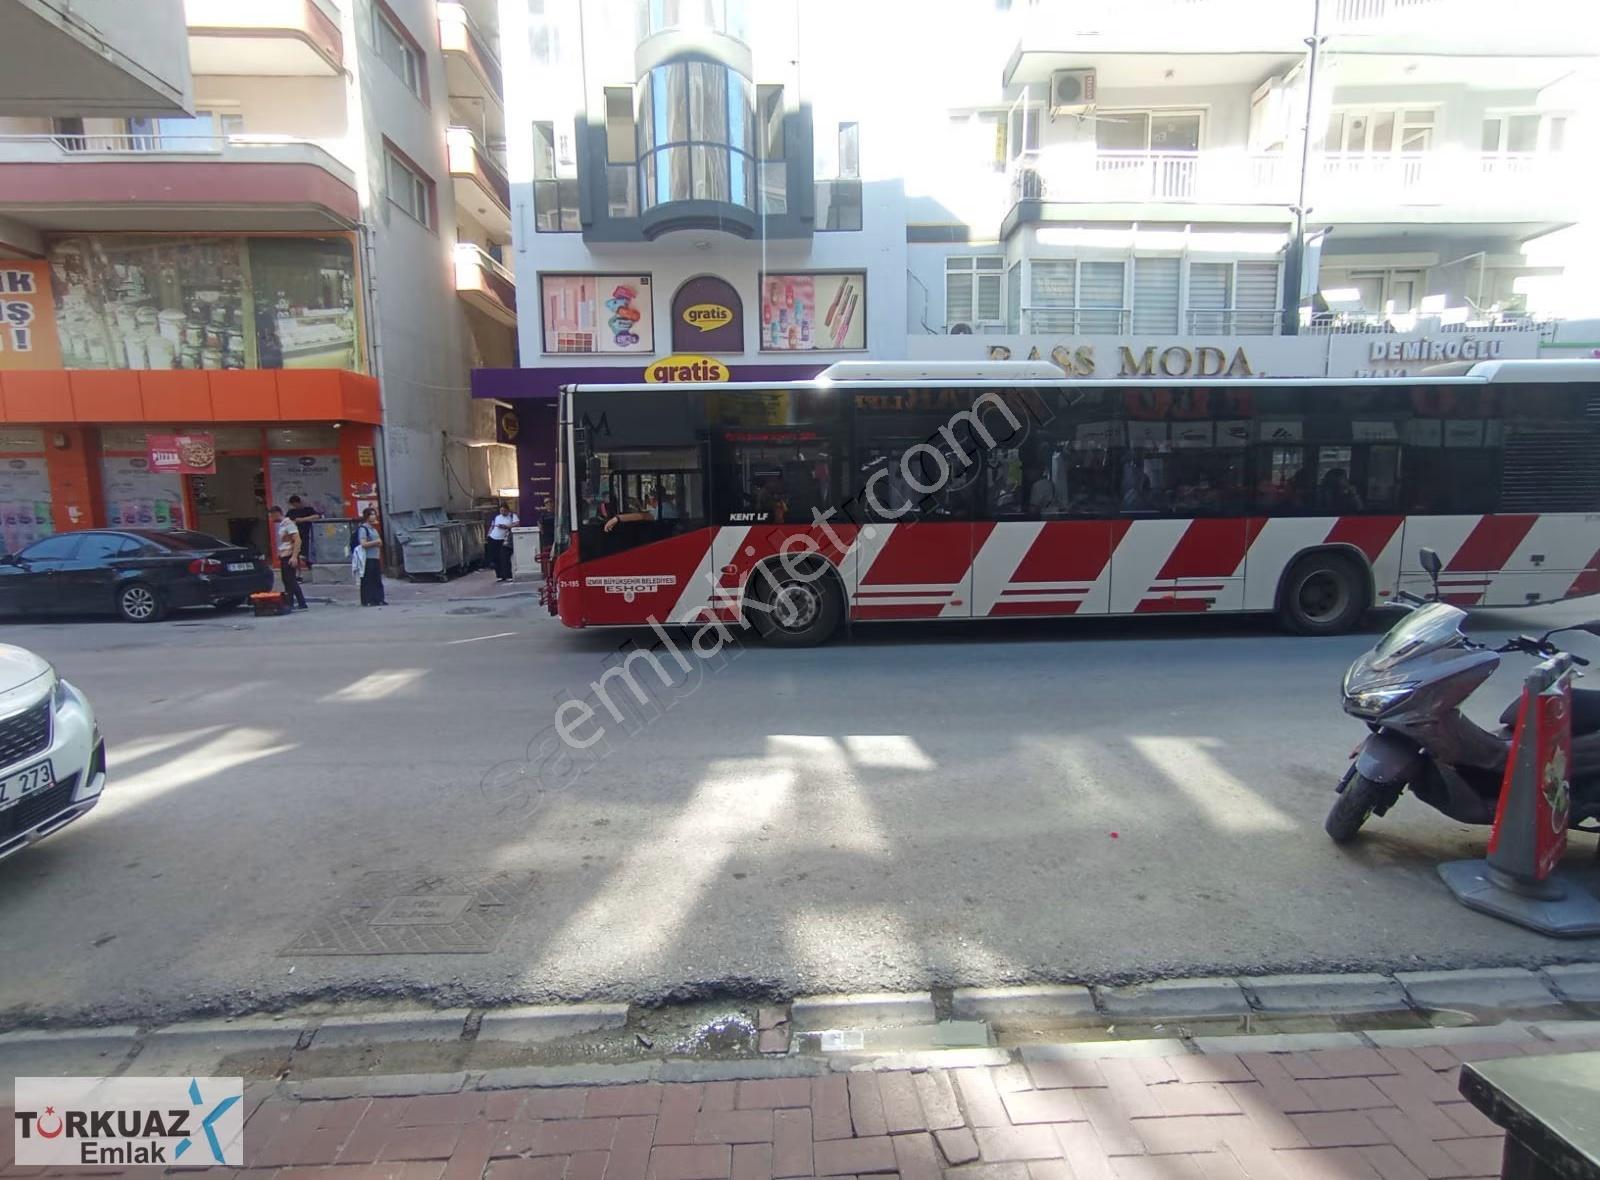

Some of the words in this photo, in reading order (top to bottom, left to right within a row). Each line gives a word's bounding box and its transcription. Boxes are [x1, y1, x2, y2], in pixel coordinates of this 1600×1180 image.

[689, 307, 727, 321] gratis
[1369, 336, 1503, 361] DEMİROĞLU
[653, 360, 721, 383] gratis
[730, 513, 755, 521] KENT
[757, 513, 769, 521] LF
[19, 765, 50, 794] 273
